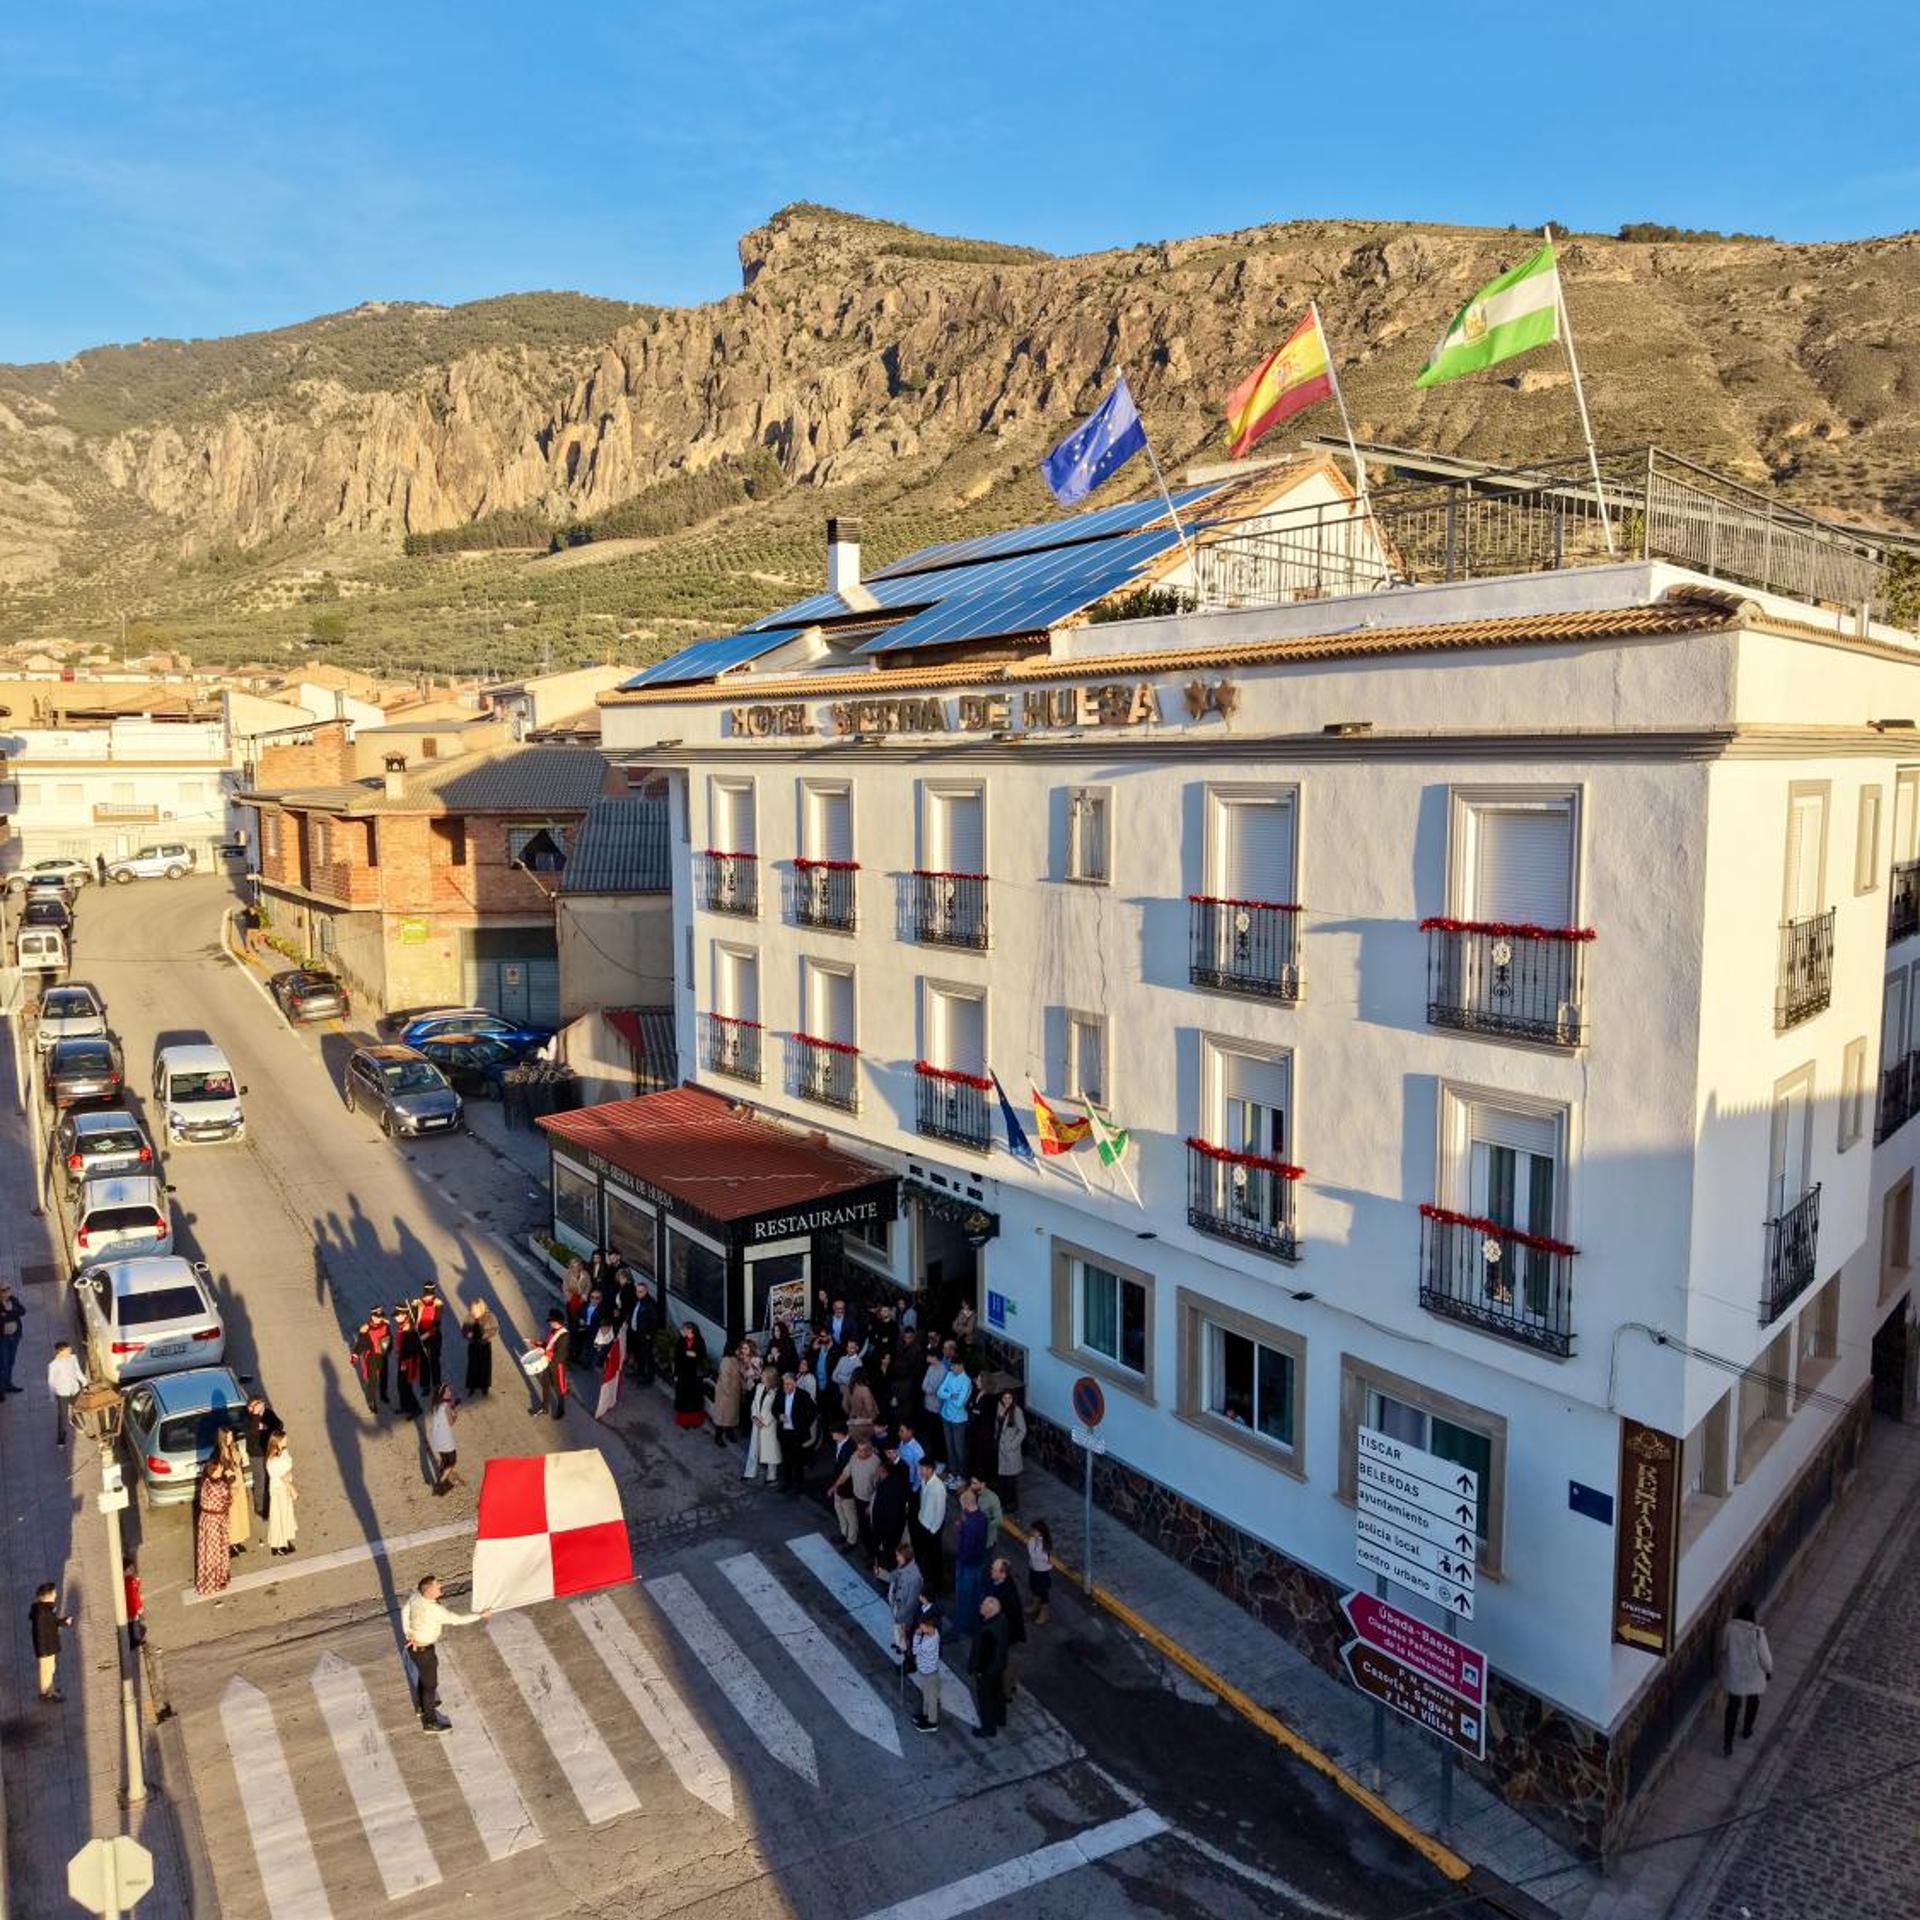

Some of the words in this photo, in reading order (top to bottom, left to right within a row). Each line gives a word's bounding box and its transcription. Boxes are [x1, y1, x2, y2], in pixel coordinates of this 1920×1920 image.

[958, 693, 1012, 730] DE
[754, 1201, 878, 1240] RESTAURANTE
[1360, 1434, 1401, 1460] TISCAR
[1359, 1463, 1420, 1497] BELERDAS
[1359, 1490, 1429, 1528] ayuntamiento
[1395, 1535, 1420, 1556] local
[1358, 1548, 1390, 1570] centro
[1394, 1565, 1431, 1591] urbano
